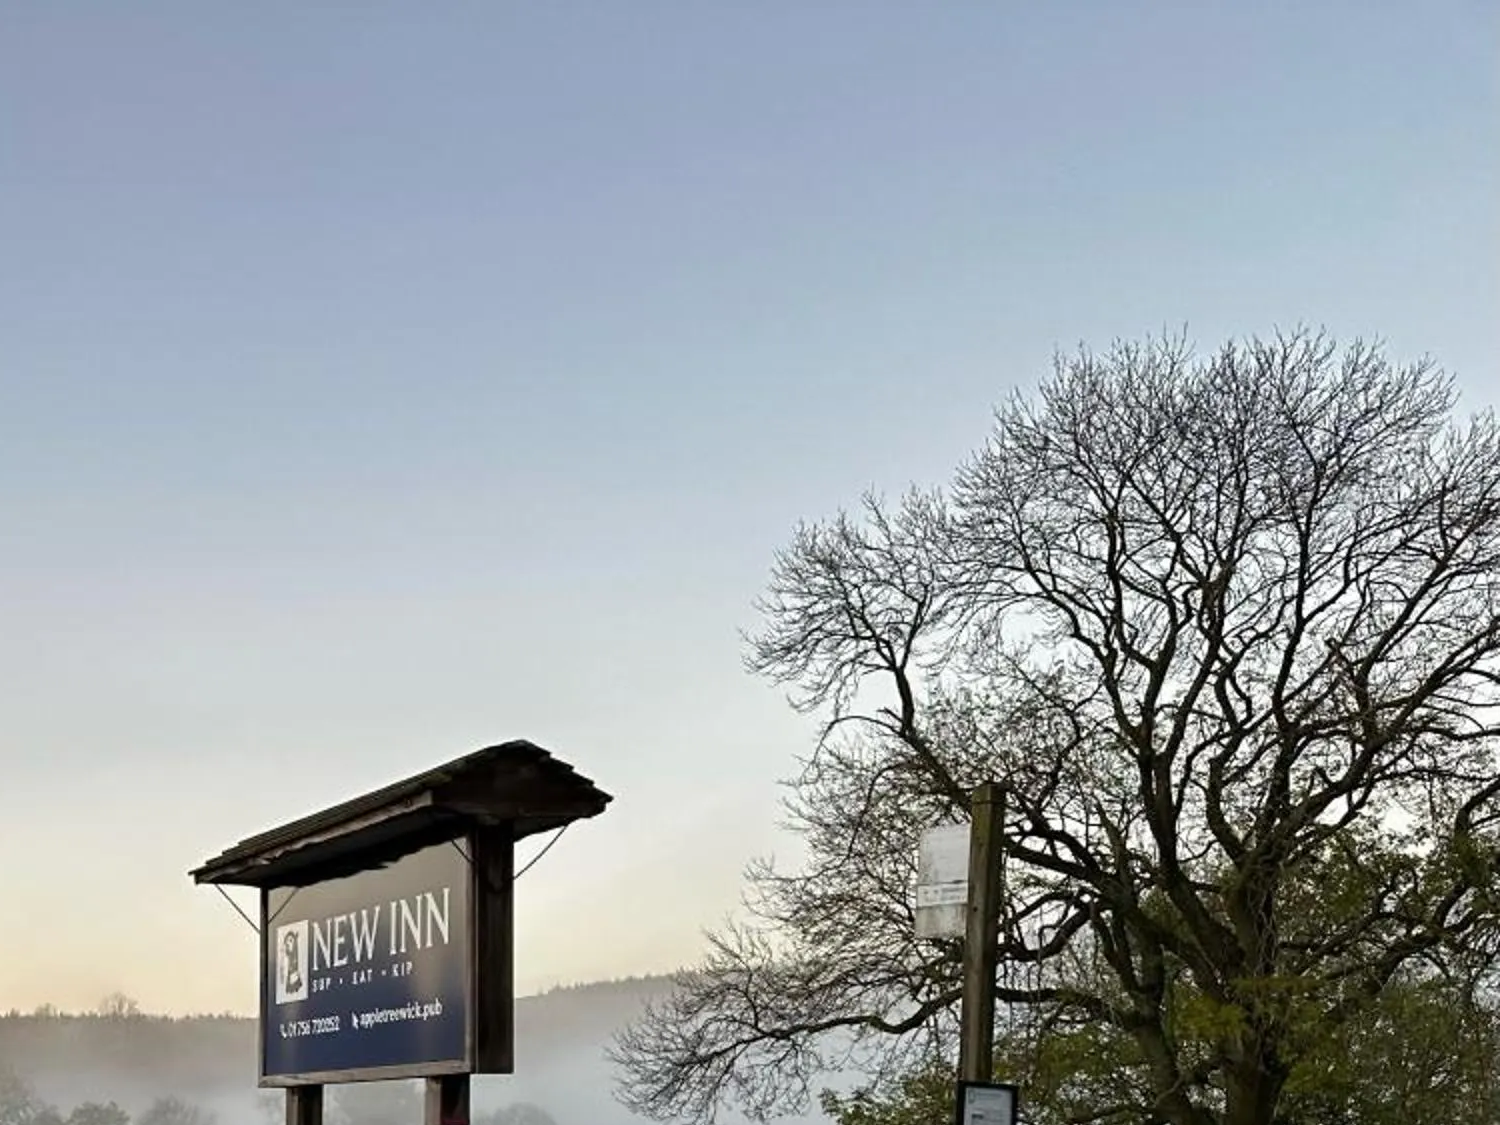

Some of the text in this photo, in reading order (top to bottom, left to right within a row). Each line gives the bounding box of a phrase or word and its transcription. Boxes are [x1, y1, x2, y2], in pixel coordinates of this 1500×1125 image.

[312, 887, 450, 972] NEW INN
[312, 961, 413, 993] SUP EAT KIP
